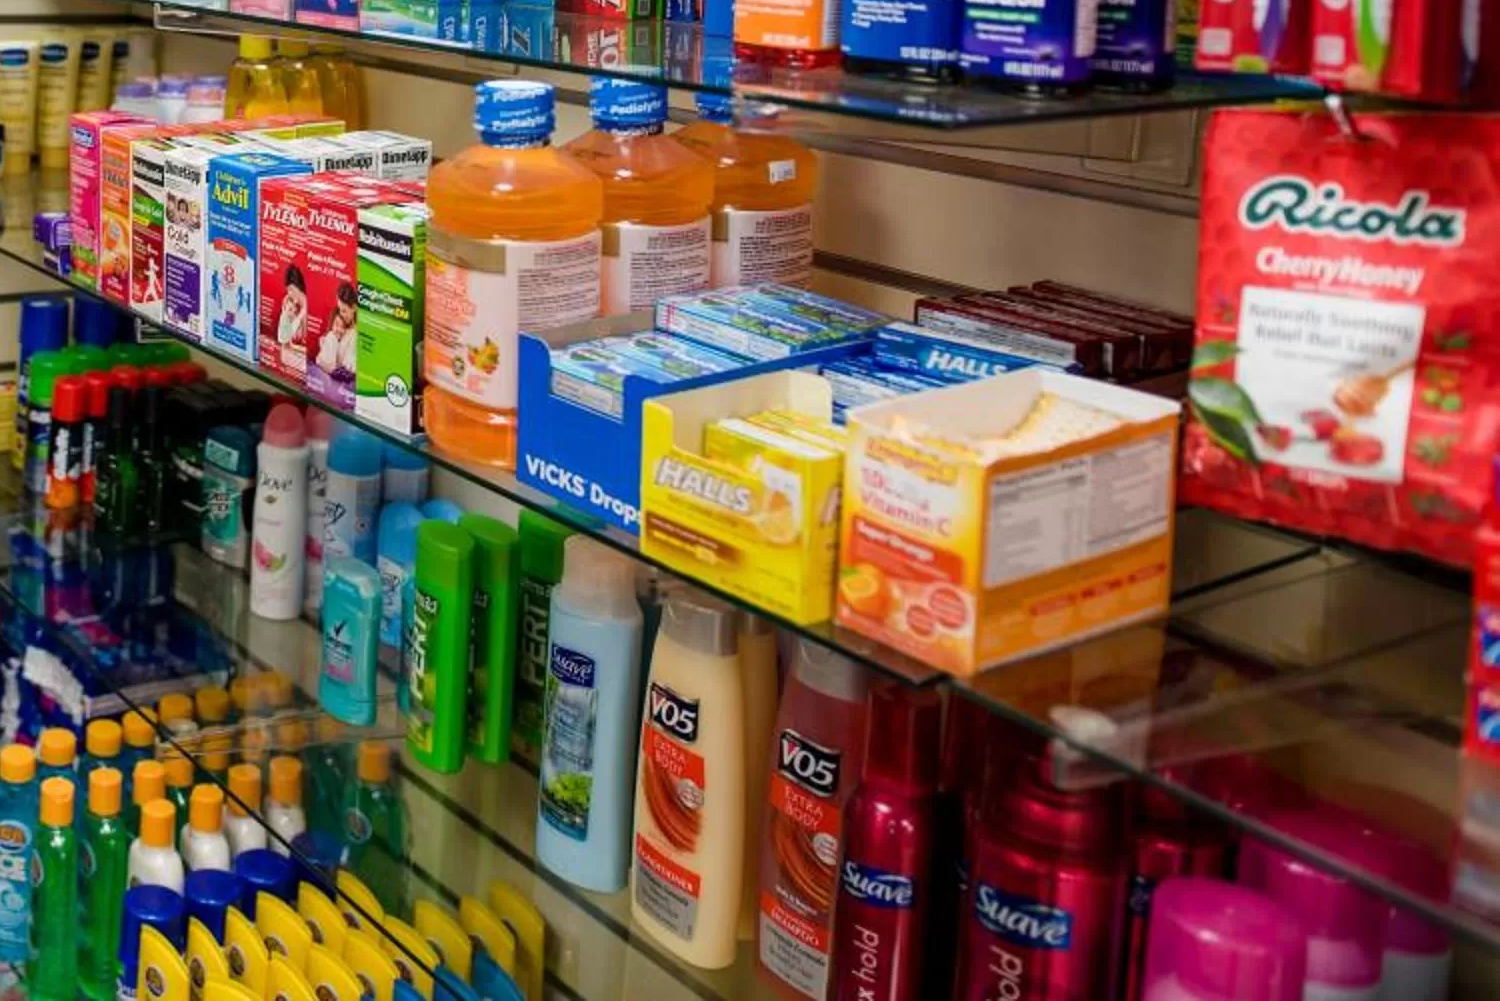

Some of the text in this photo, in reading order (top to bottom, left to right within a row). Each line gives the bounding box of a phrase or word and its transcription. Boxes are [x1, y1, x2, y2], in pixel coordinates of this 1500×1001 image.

[212, 183, 249, 209] Advil
[1244, 180, 1464, 242] Ricola
[307, 207, 355, 236] TYLENOL
[926, 348, 1008, 379] HALLS
[525, 453, 587, 498] VICKS
[655, 455, 755, 515] HALLS
[650, 692, 696, 735] VO5
[781, 739, 837, 786] VO5
[844, 861, 912, 905] Suave
[976, 885, 1069, 948] Suave
[853, 925, 880, 980] hold
